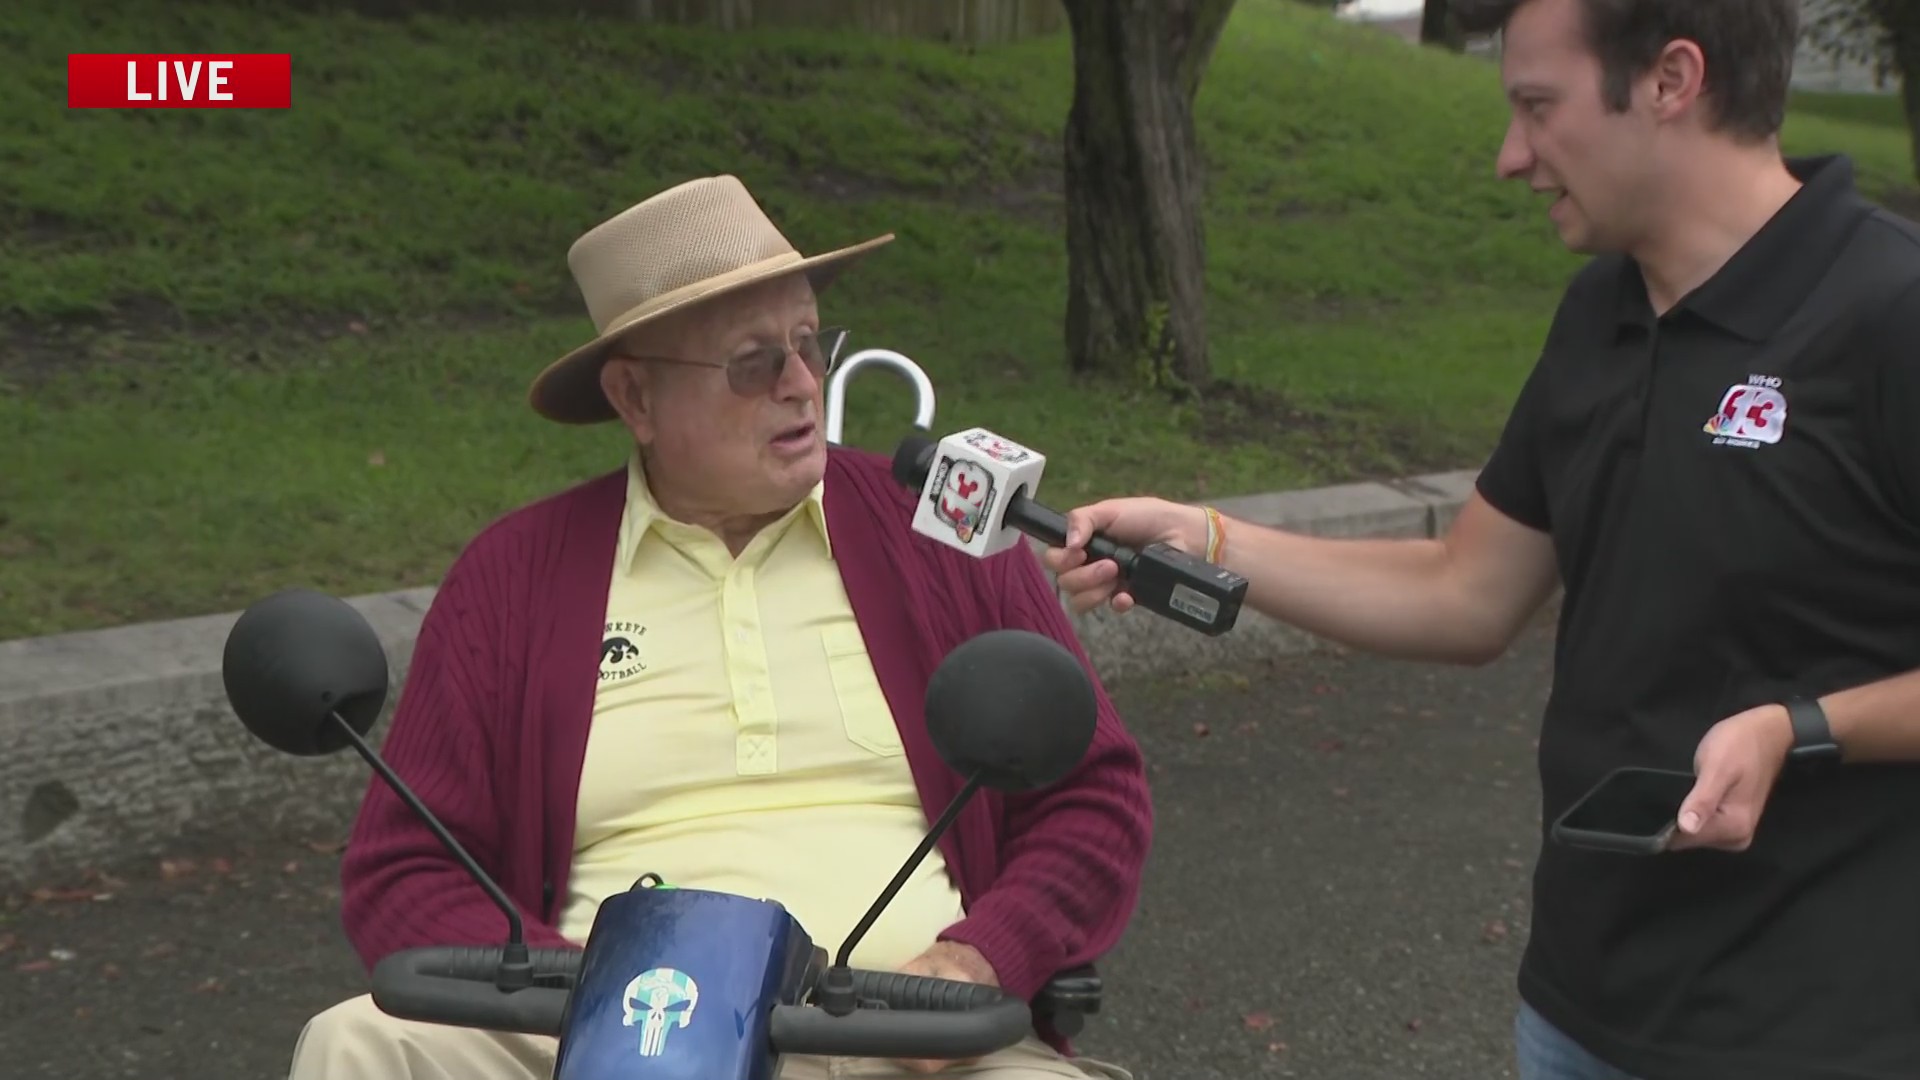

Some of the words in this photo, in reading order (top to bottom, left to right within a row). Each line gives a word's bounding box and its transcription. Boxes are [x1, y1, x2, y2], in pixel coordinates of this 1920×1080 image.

[1748, 374, 1782, 389] WHO
[1725, 385, 1788, 444] 13
[940, 459, 990, 523] 13
[605, 621, 647, 636] WKEYE
[598, 662, 647, 681] OOTBALL
